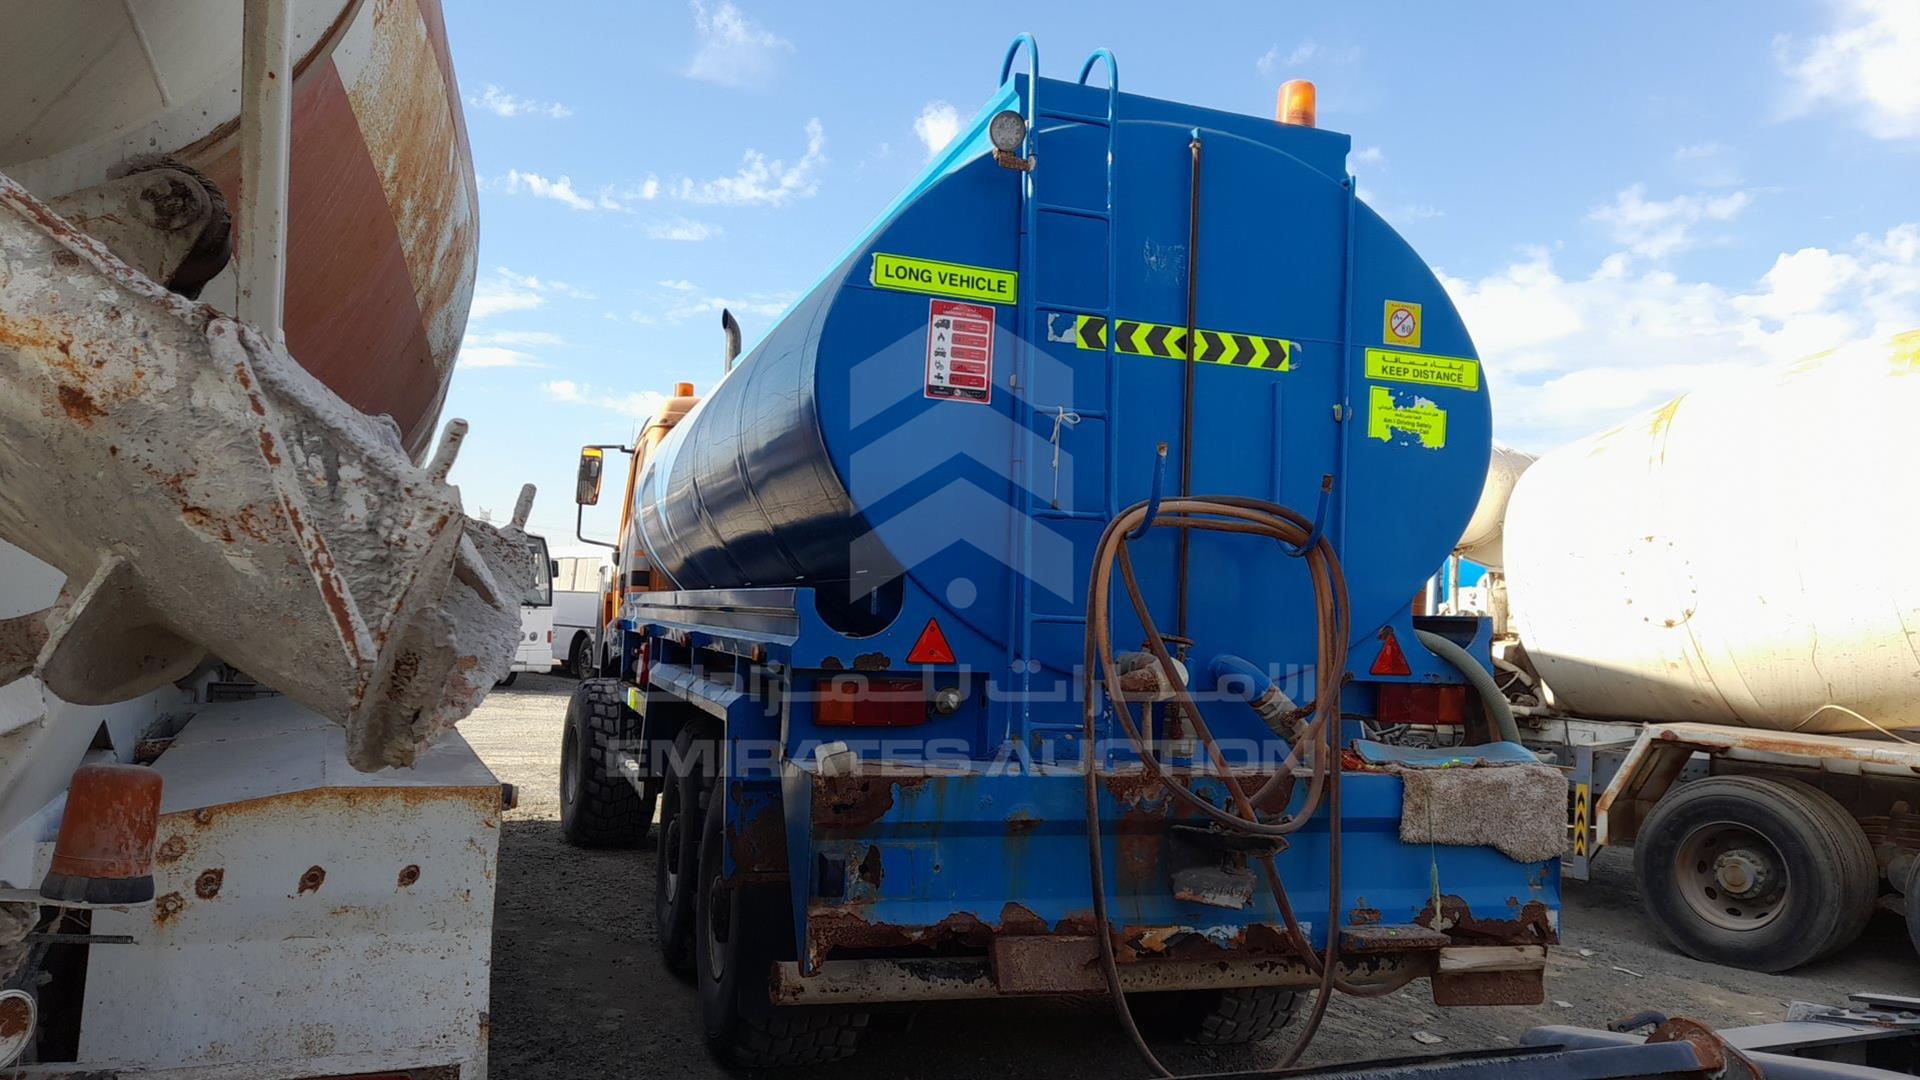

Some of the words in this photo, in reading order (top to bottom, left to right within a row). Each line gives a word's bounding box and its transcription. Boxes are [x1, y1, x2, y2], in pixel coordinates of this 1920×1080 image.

[885, 263, 932, 283] LONG
[938, 271, 1007, 293] VEHICLE
[1382, 365, 1410, 377] KEEP
[1413, 368, 1463, 384] DISTANCE
